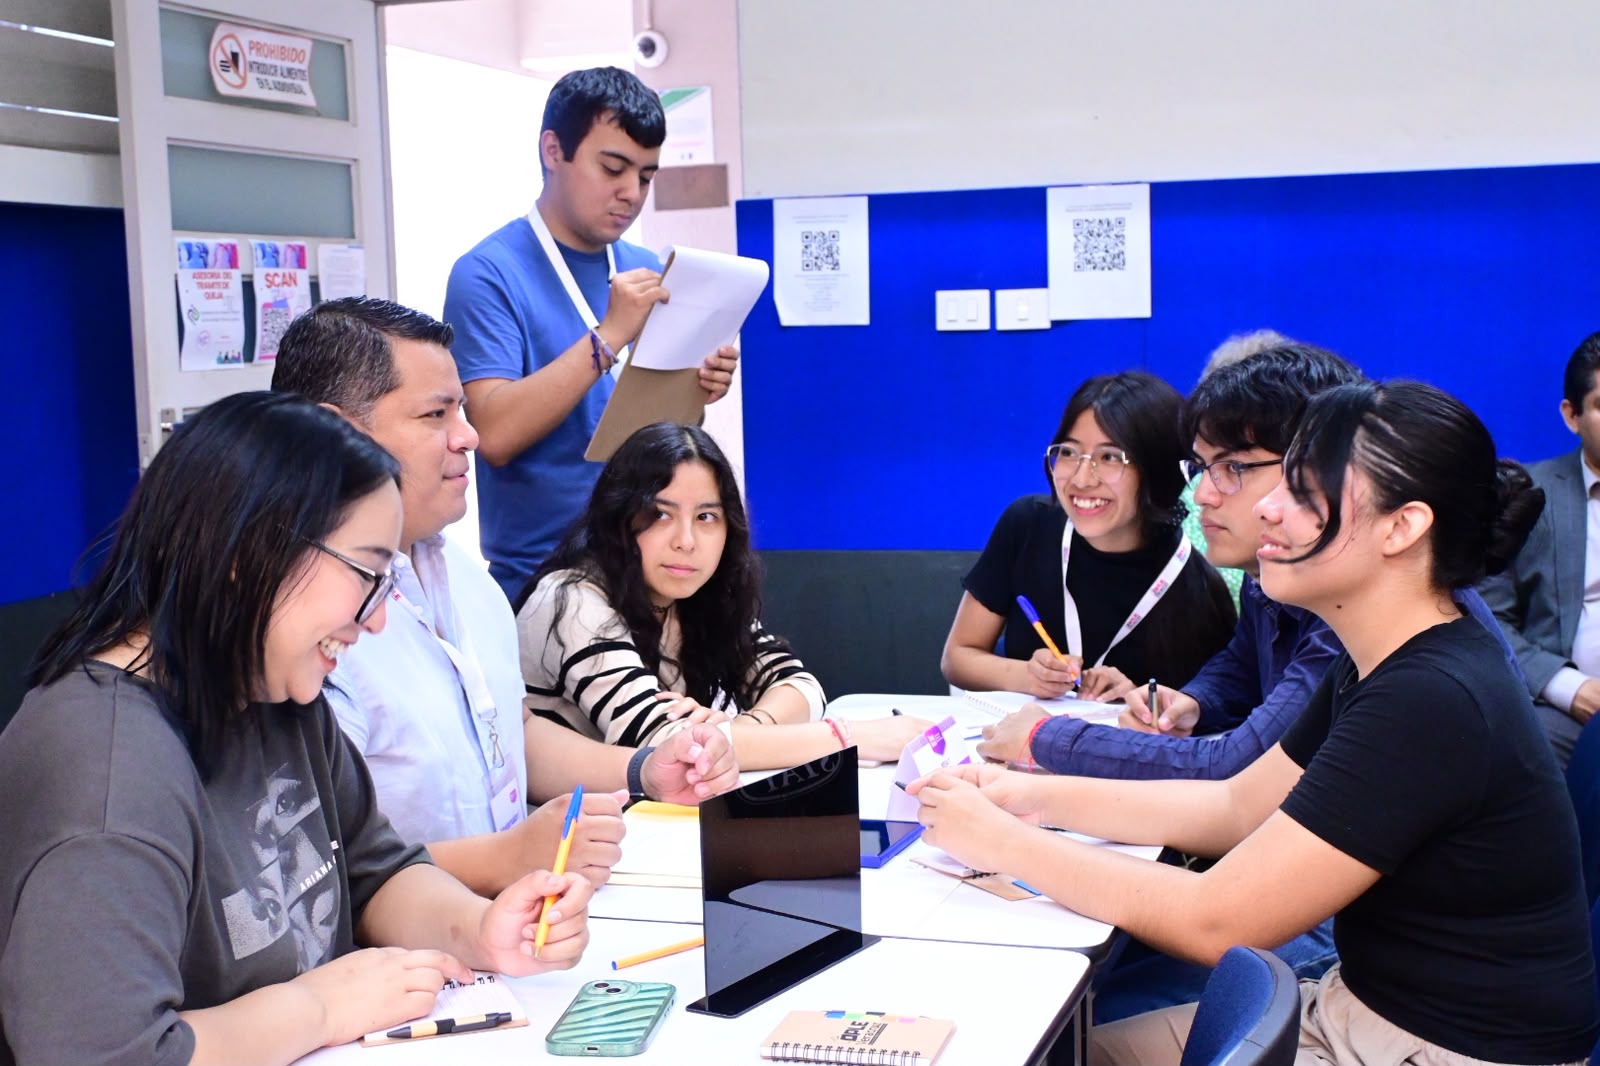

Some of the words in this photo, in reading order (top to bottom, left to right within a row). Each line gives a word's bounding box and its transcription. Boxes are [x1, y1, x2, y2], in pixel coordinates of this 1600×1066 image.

[248, 40, 306, 64] PROHIBIDO
[264, 271, 298, 288] SCAN
[300, 861, 333, 892] ARIANA
[840, 1020, 869, 1042] OPLE
